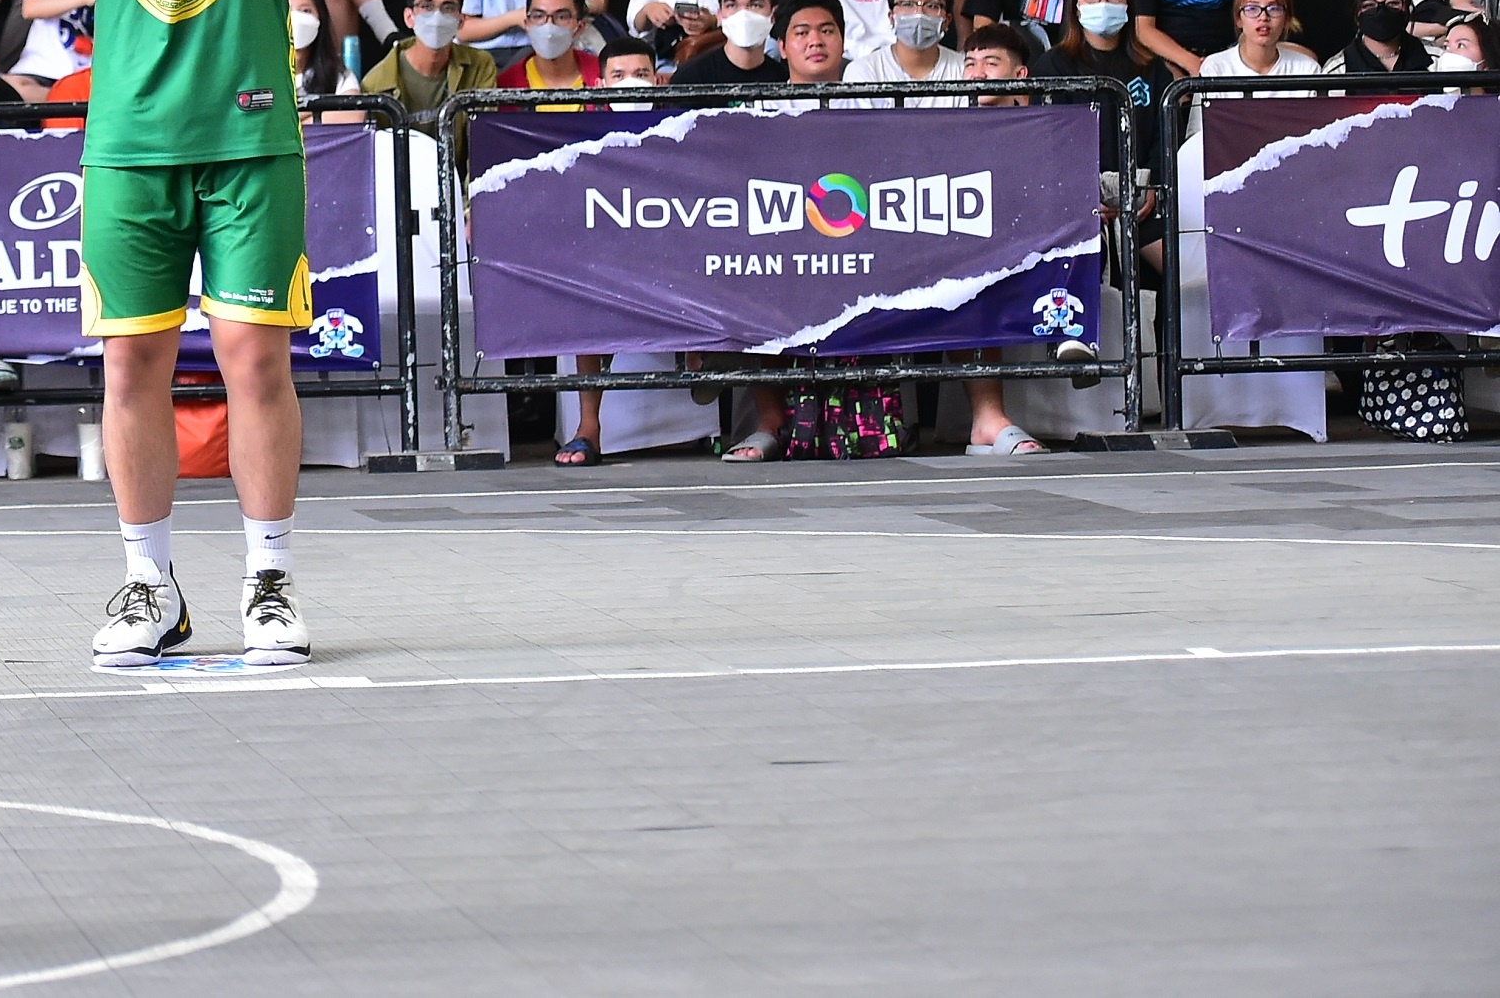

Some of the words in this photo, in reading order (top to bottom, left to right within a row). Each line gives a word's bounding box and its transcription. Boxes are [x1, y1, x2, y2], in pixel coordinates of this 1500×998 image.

[705, 254, 783, 276] PHAN
[792, 253, 875, 275] THIET
[19, 299, 42, 314] TO
[44, 297, 77, 313] THE
